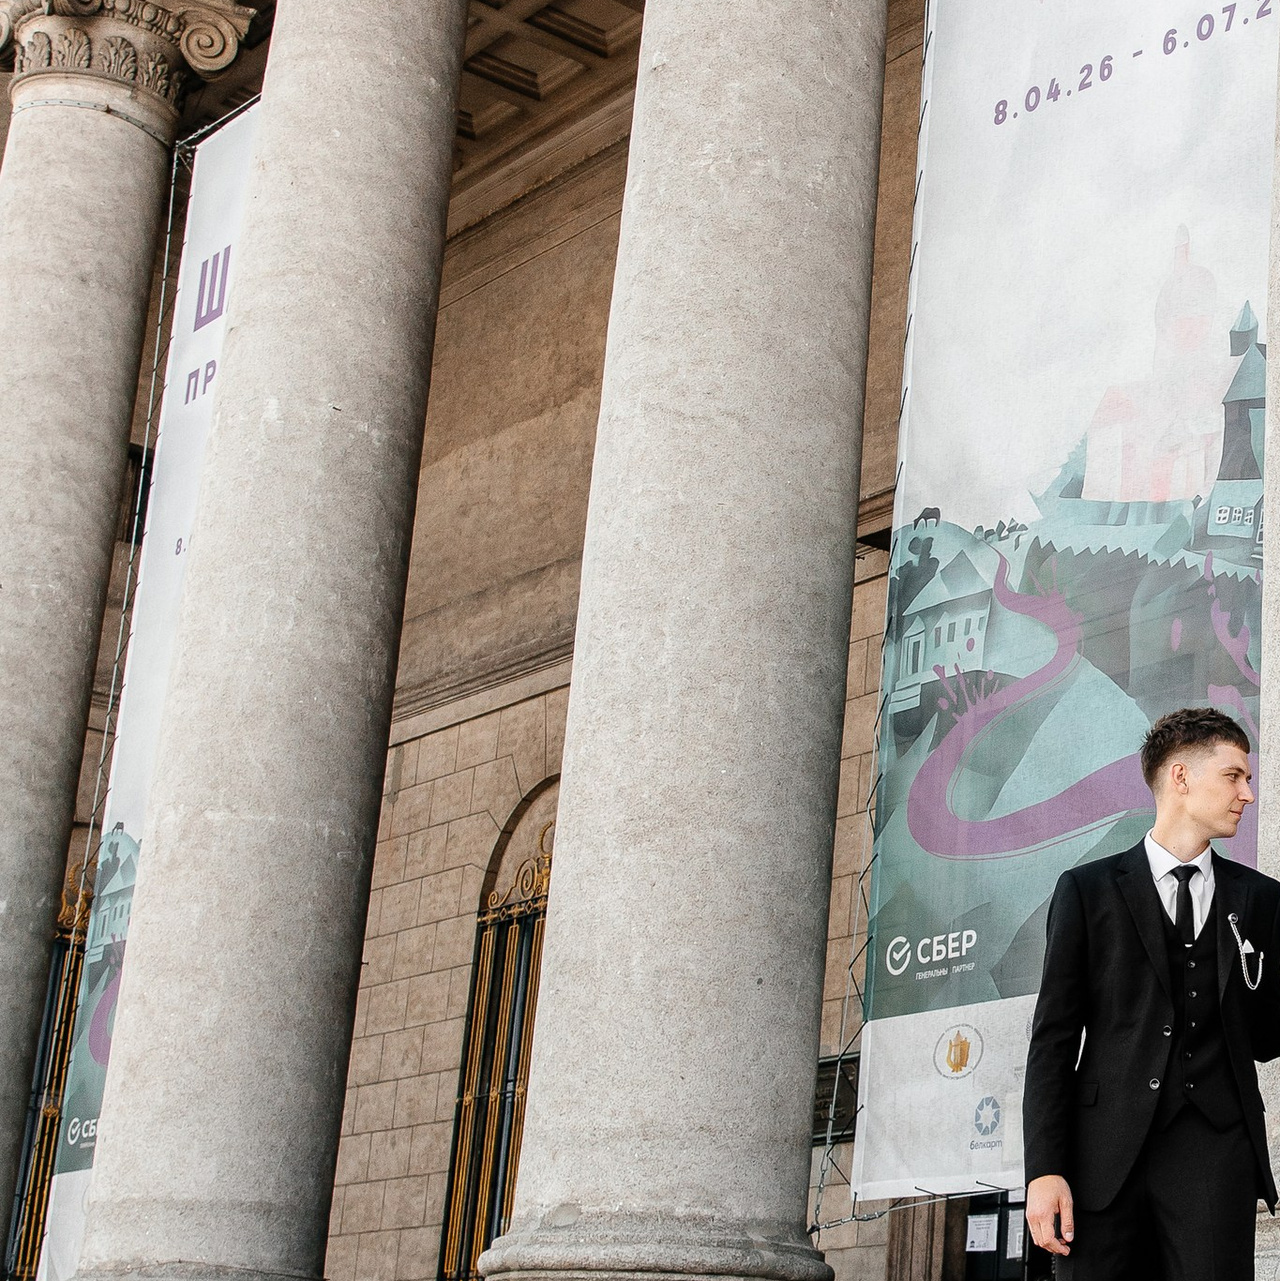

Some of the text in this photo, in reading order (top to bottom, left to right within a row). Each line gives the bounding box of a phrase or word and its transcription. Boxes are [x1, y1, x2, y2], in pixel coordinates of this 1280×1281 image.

[994, 55, 1113, 125] 8.04.26
[193, 245, 231, 332] Ш
[175, 535, 191, 556] 8.
[917, 929, 977, 964] СБЕР
[952, 962, 975, 974] ПАРТНЕР
[969, 1138, 1003, 1151] белкарт
